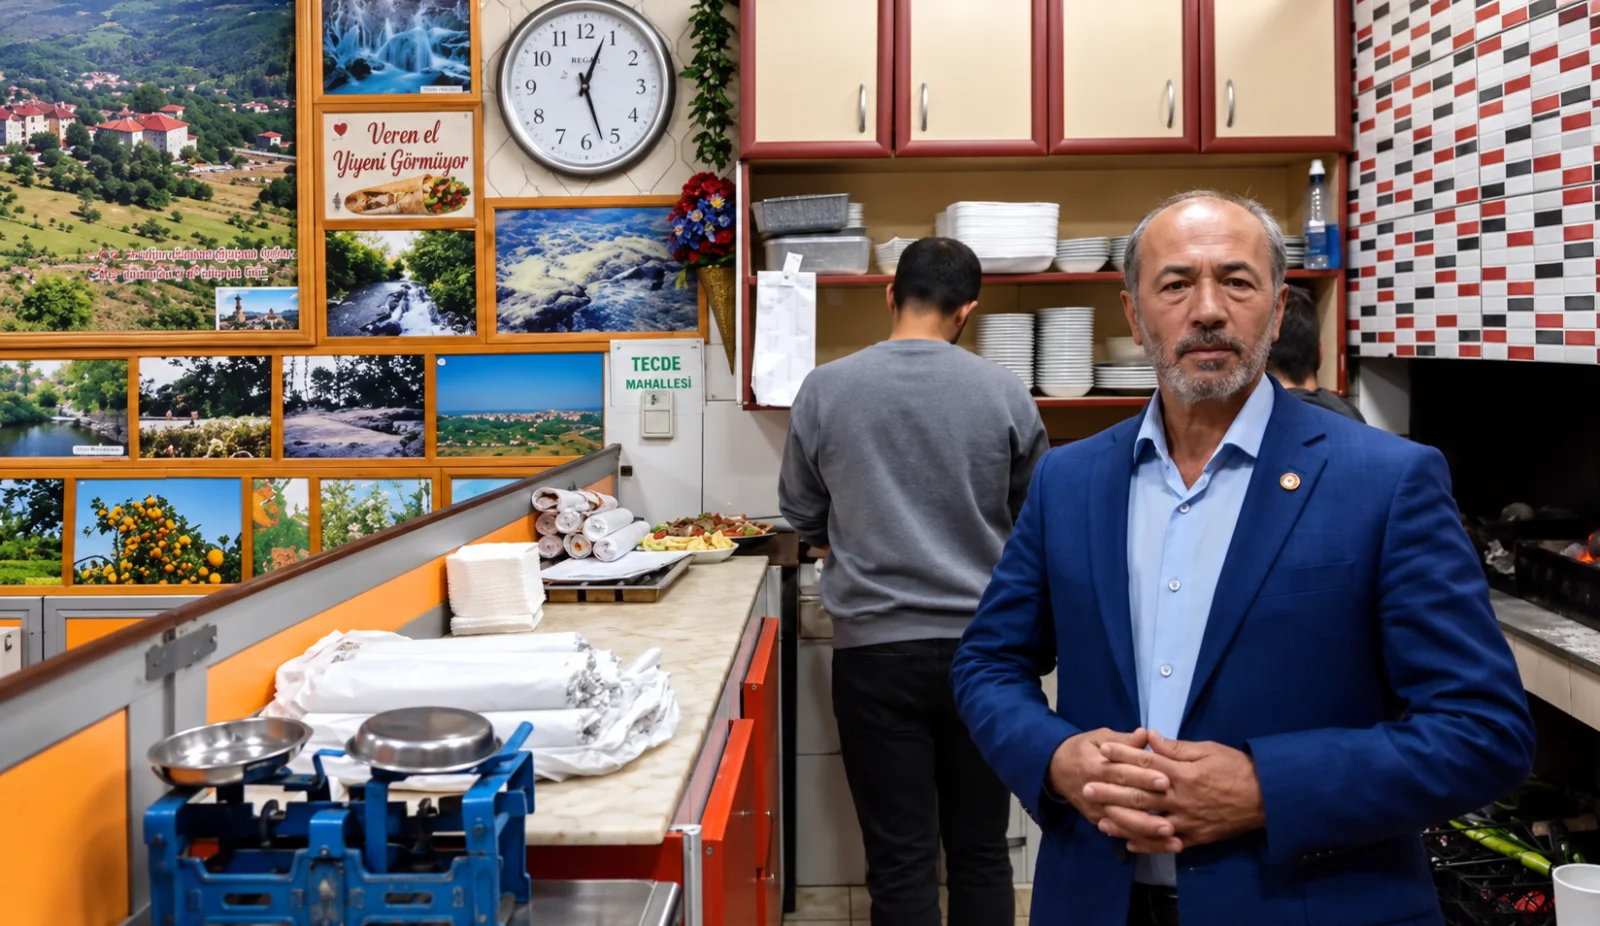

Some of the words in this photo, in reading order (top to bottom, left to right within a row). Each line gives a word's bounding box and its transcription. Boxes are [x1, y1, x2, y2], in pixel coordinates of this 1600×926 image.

[552, 31, 567, 47] 11
[577, 23, 595, 39] 12
[609, 30, 616, 46] 1
[533, 50, 551, 67] 10
[628, 50, 638, 66] 2
[526, 79, 537, 95] 9
[636, 79, 646, 94] 3
[534, 108, 544, 124] 8
[628, 107, 638, 122] 4
[367, 121, 419, 145] Veren
[424, 119, 441, 144] el
[555, 128, 566, 144] 7
[610, 128, 620, 144] 5
[581, 134, 592, 150] 6
[333, 150, 386, 178] Yiyeni
[390, 149, 469, 177] Görmüyor
[631, 356, 681, 372] TECDE
[626, 376, 692, 390] MAHALLESİ
